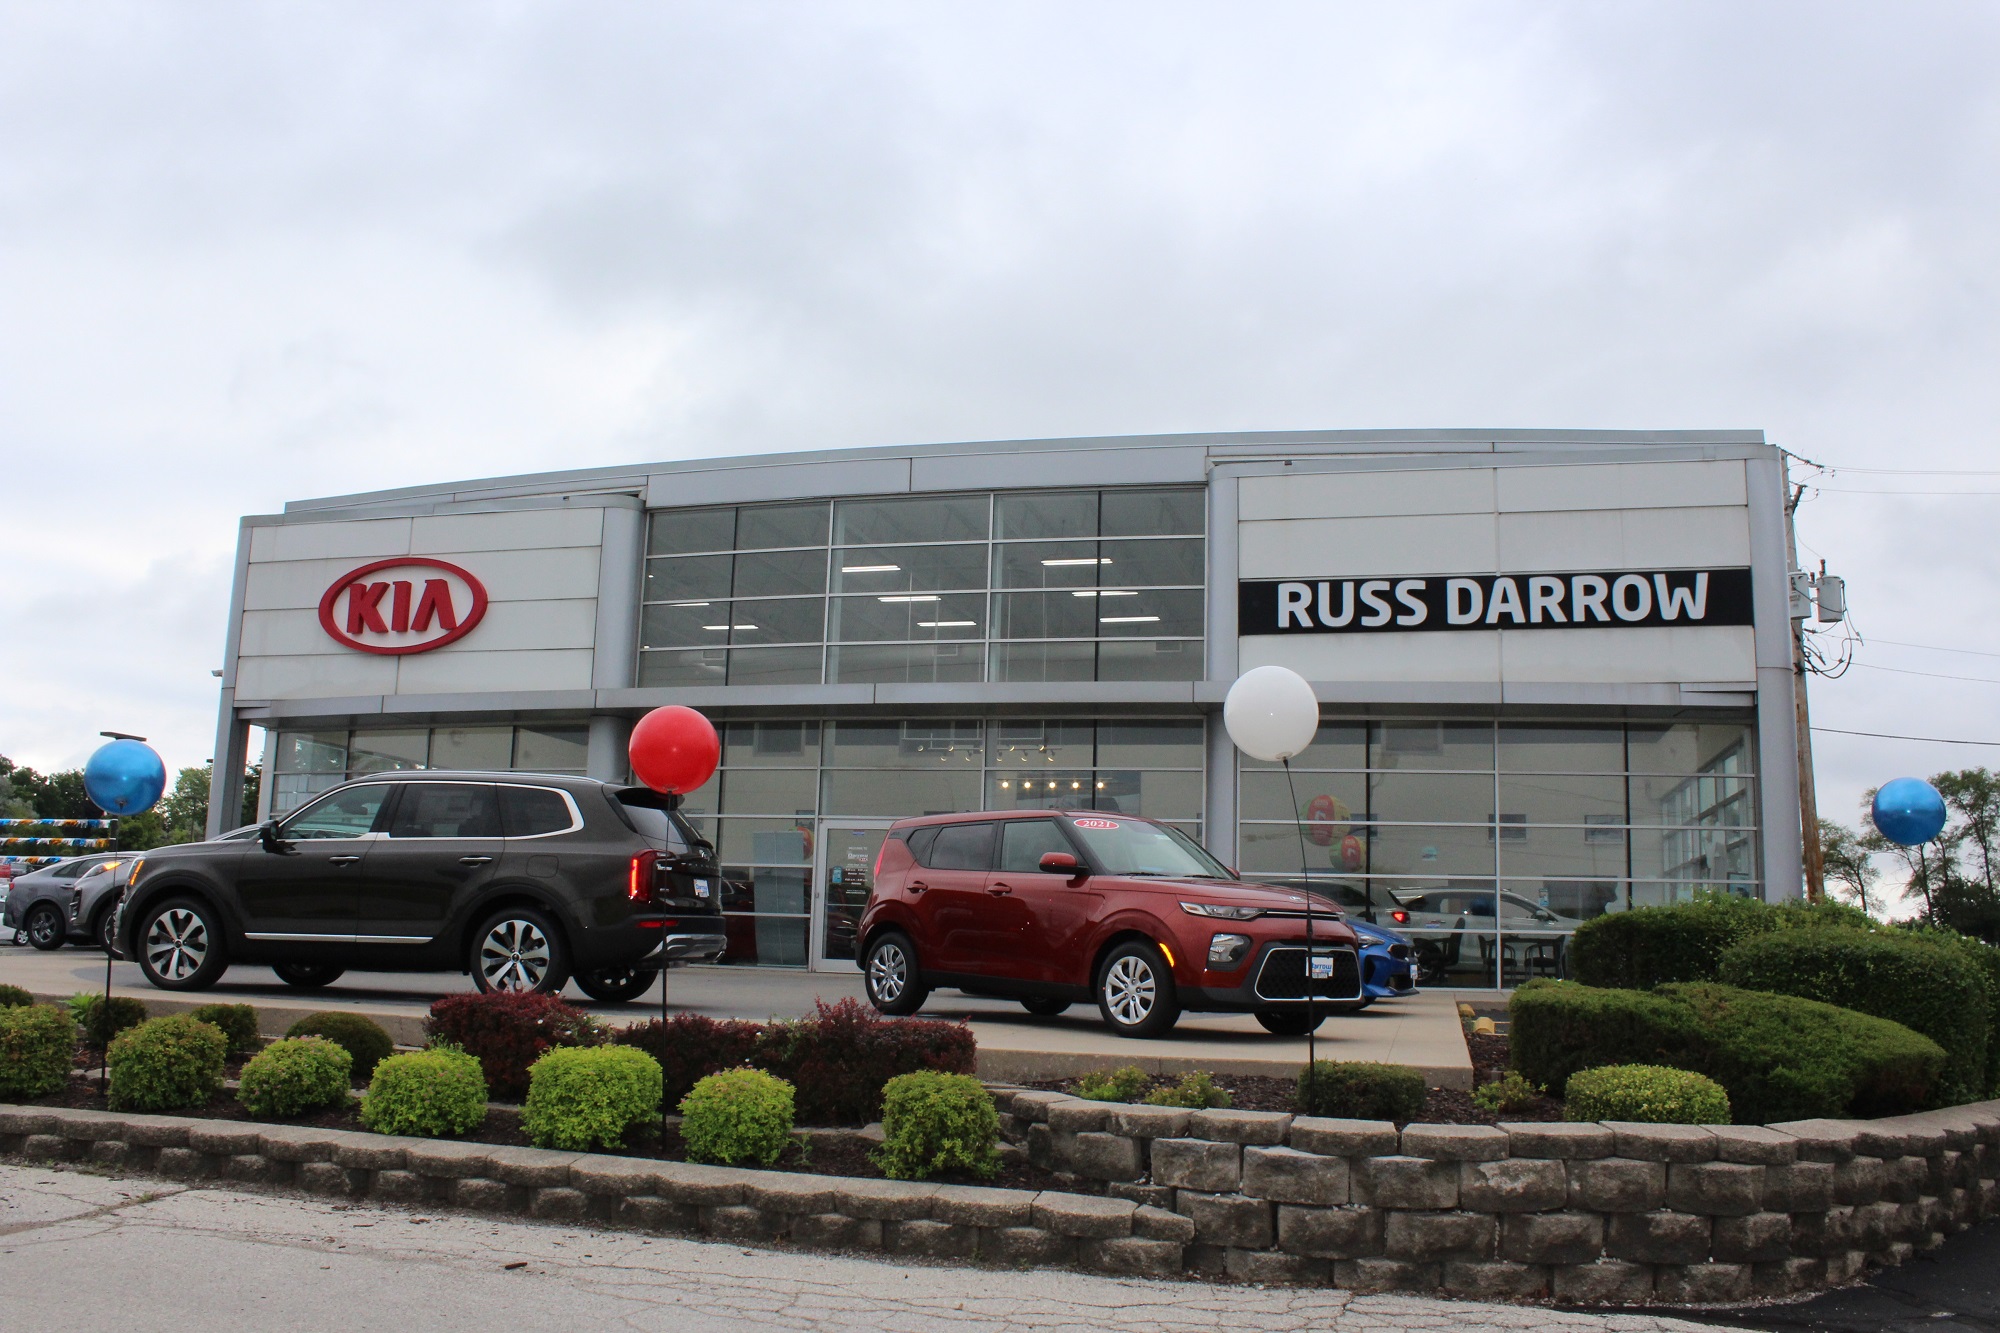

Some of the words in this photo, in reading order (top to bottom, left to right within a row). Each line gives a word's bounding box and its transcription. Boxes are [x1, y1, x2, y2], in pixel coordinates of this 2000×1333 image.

[346, 579, 458, 635] KIA
[1277, 579, 1428, 628] RUSS
[1446, 572, 1710, 625] DARROW
[1083, 820, 1111, 828] 2021
